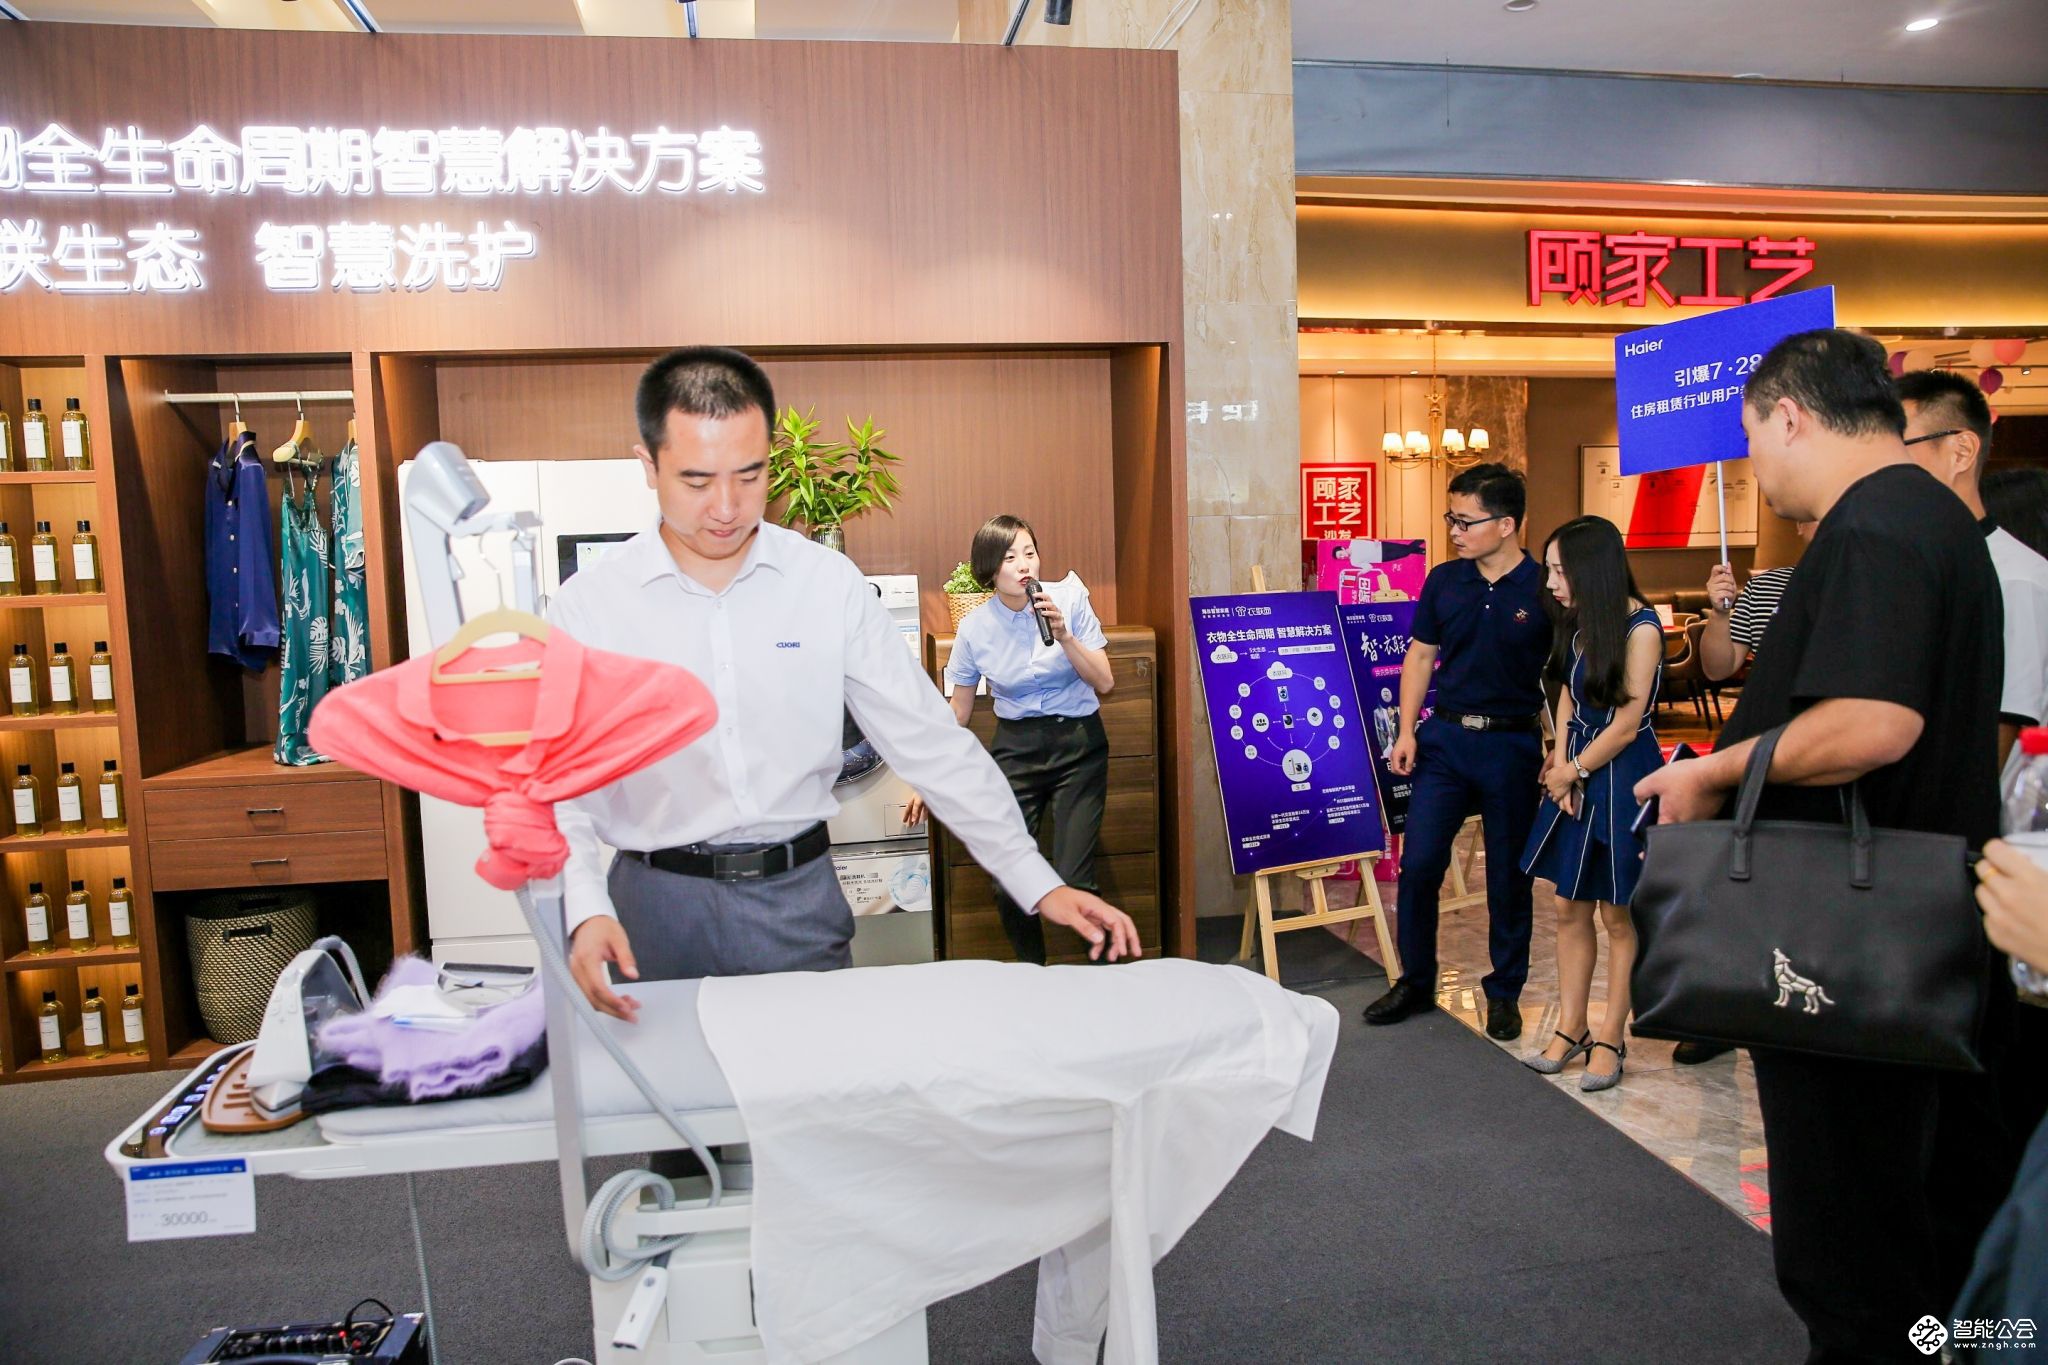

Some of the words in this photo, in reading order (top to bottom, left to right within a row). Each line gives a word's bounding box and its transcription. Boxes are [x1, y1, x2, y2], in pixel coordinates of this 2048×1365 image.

[255, 220, 537, 292] 智慧洗护
[1527, 229, 1817, 308] 顾家工艺
[1624, 339, 1663, 358] Haier
[1631, 384, 1745, 419] 住房租赁行业用户
[1312, 477, 1361, 501] 顾家
[1312, 502, 1361, 526] 工艺
[1206, 628, 1275, 643] 衣物全生命周期
[1276, 624, 1333, 639] 智慧解决方案
